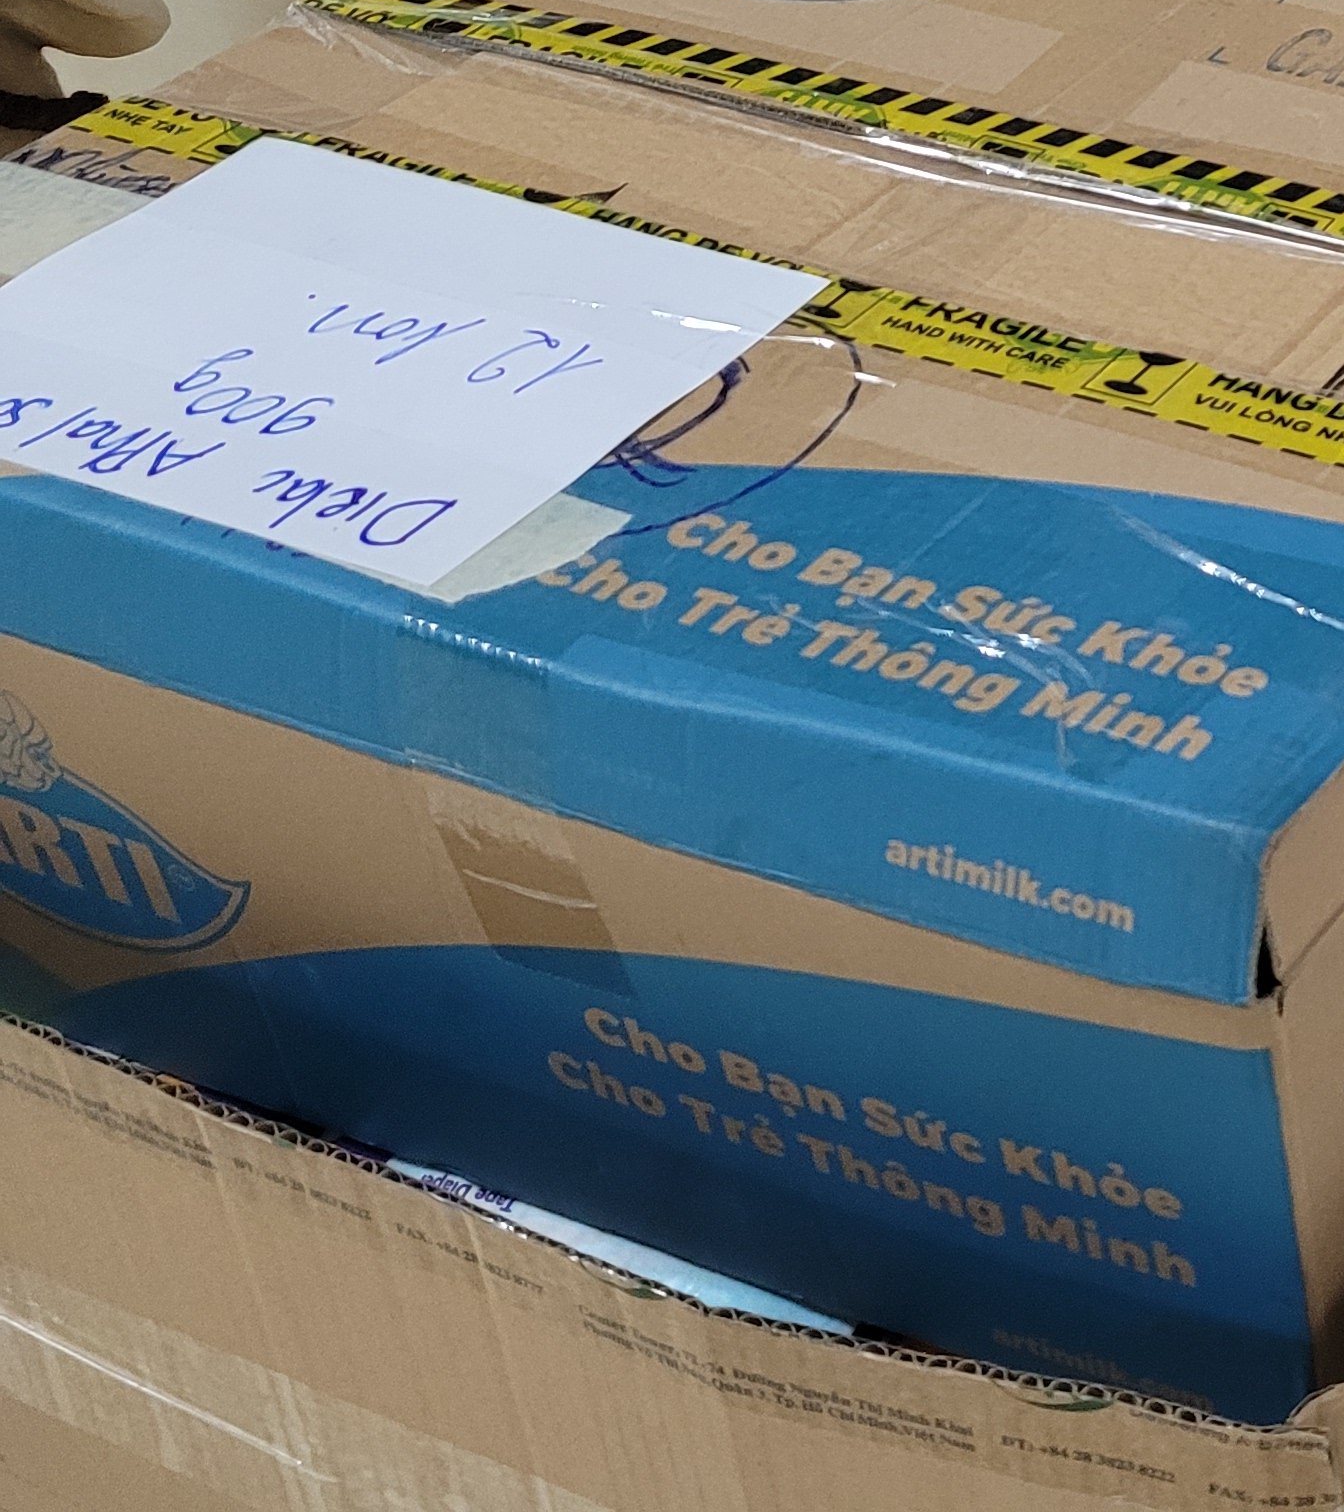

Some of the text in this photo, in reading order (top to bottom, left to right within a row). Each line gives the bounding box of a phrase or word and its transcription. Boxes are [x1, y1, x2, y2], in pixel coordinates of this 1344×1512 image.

[103, 108, 152, 128] NHẸ
[150, 118, 195, 137] TAY
[880, 315, 1072, 373] HAND WITH CARE
[896, 289, 1091, 357] FRAGILE
[174, 350, 336, 436] 900g
[1192, 391, 1242, 420] VUI
[1235, 396, 1315, 442] LÒNG
[664, 510, 1271, 700] Cho Bạn Sức Khỏe
[533, 556, 1214, 763] Cho Trẻ Thông Minh
[883, 838, 1138, 932] artimilk.com
[583, 1005, 1186, 1223] Cho Bạn Sức Khỏe
[547, 1050, 1198, 1289] Cho Trẻ Thông Minh
